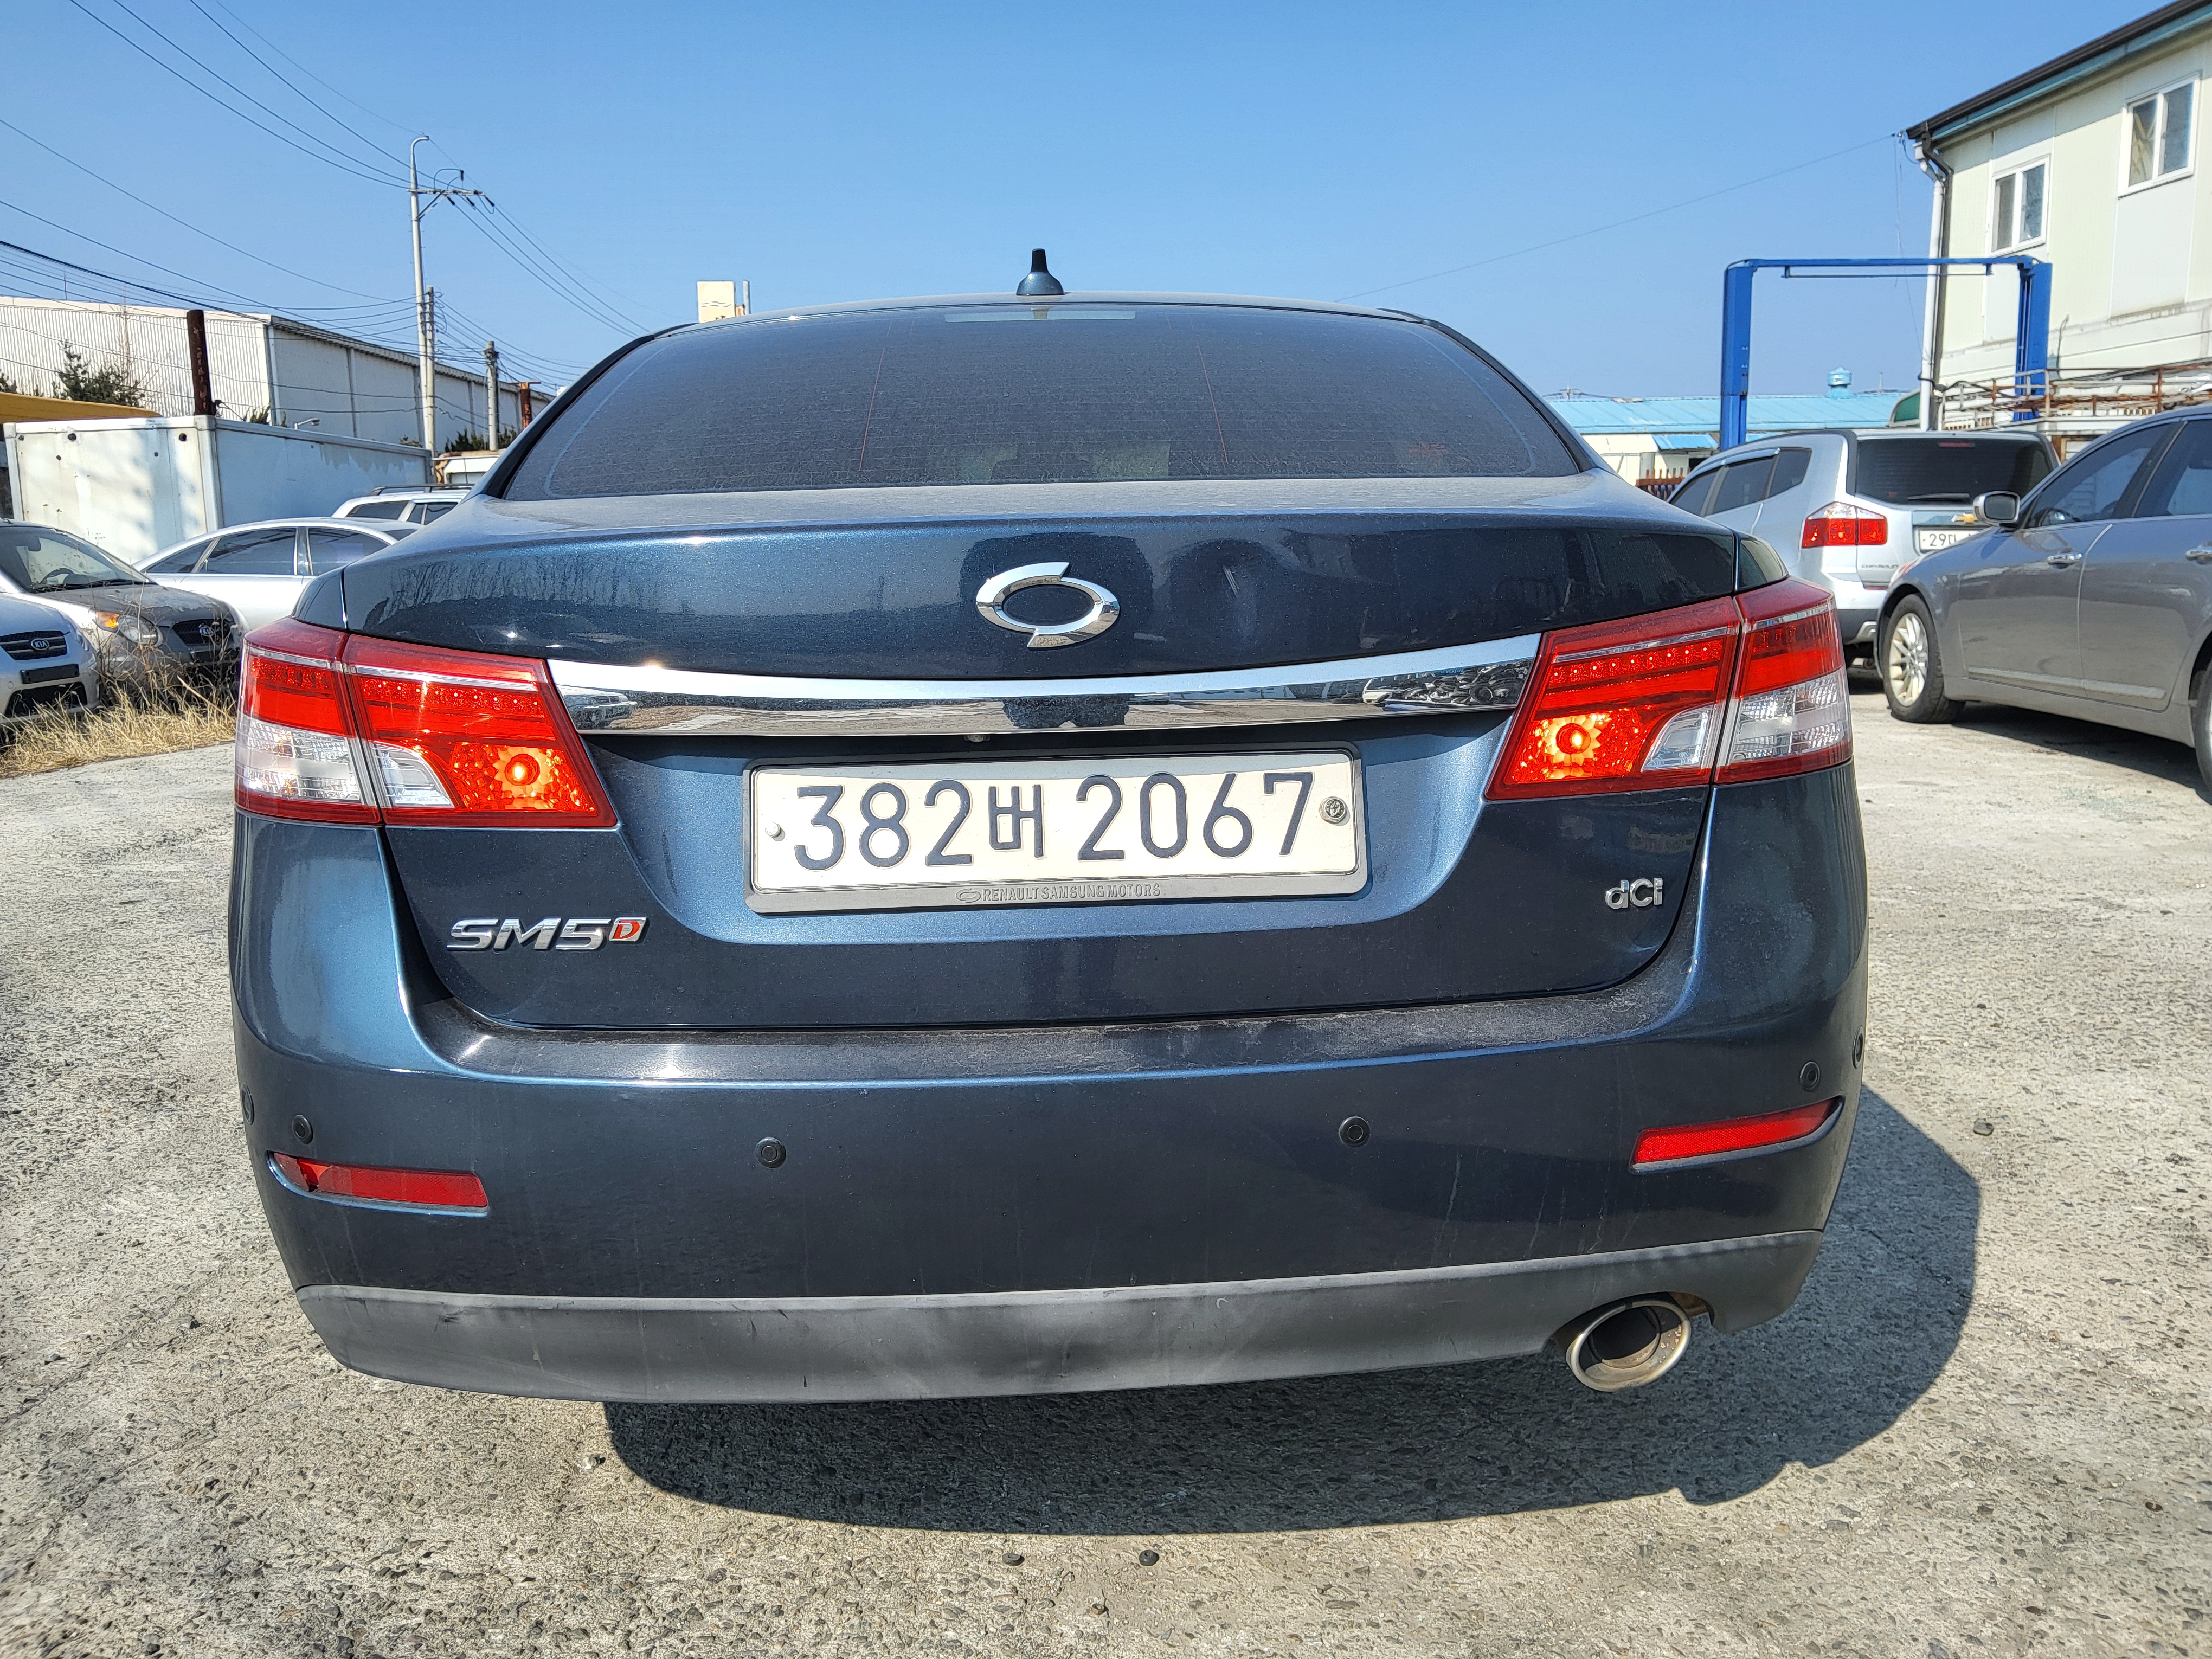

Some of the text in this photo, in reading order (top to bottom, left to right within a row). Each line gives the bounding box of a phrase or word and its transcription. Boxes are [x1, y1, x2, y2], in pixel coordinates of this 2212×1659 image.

[794, 772, 1314, 871] 382버 2067
[982, 883, 1161, 902] RENAULT SAMSUNG MOTORS
[1605, 877, 1663, 910] dCi
